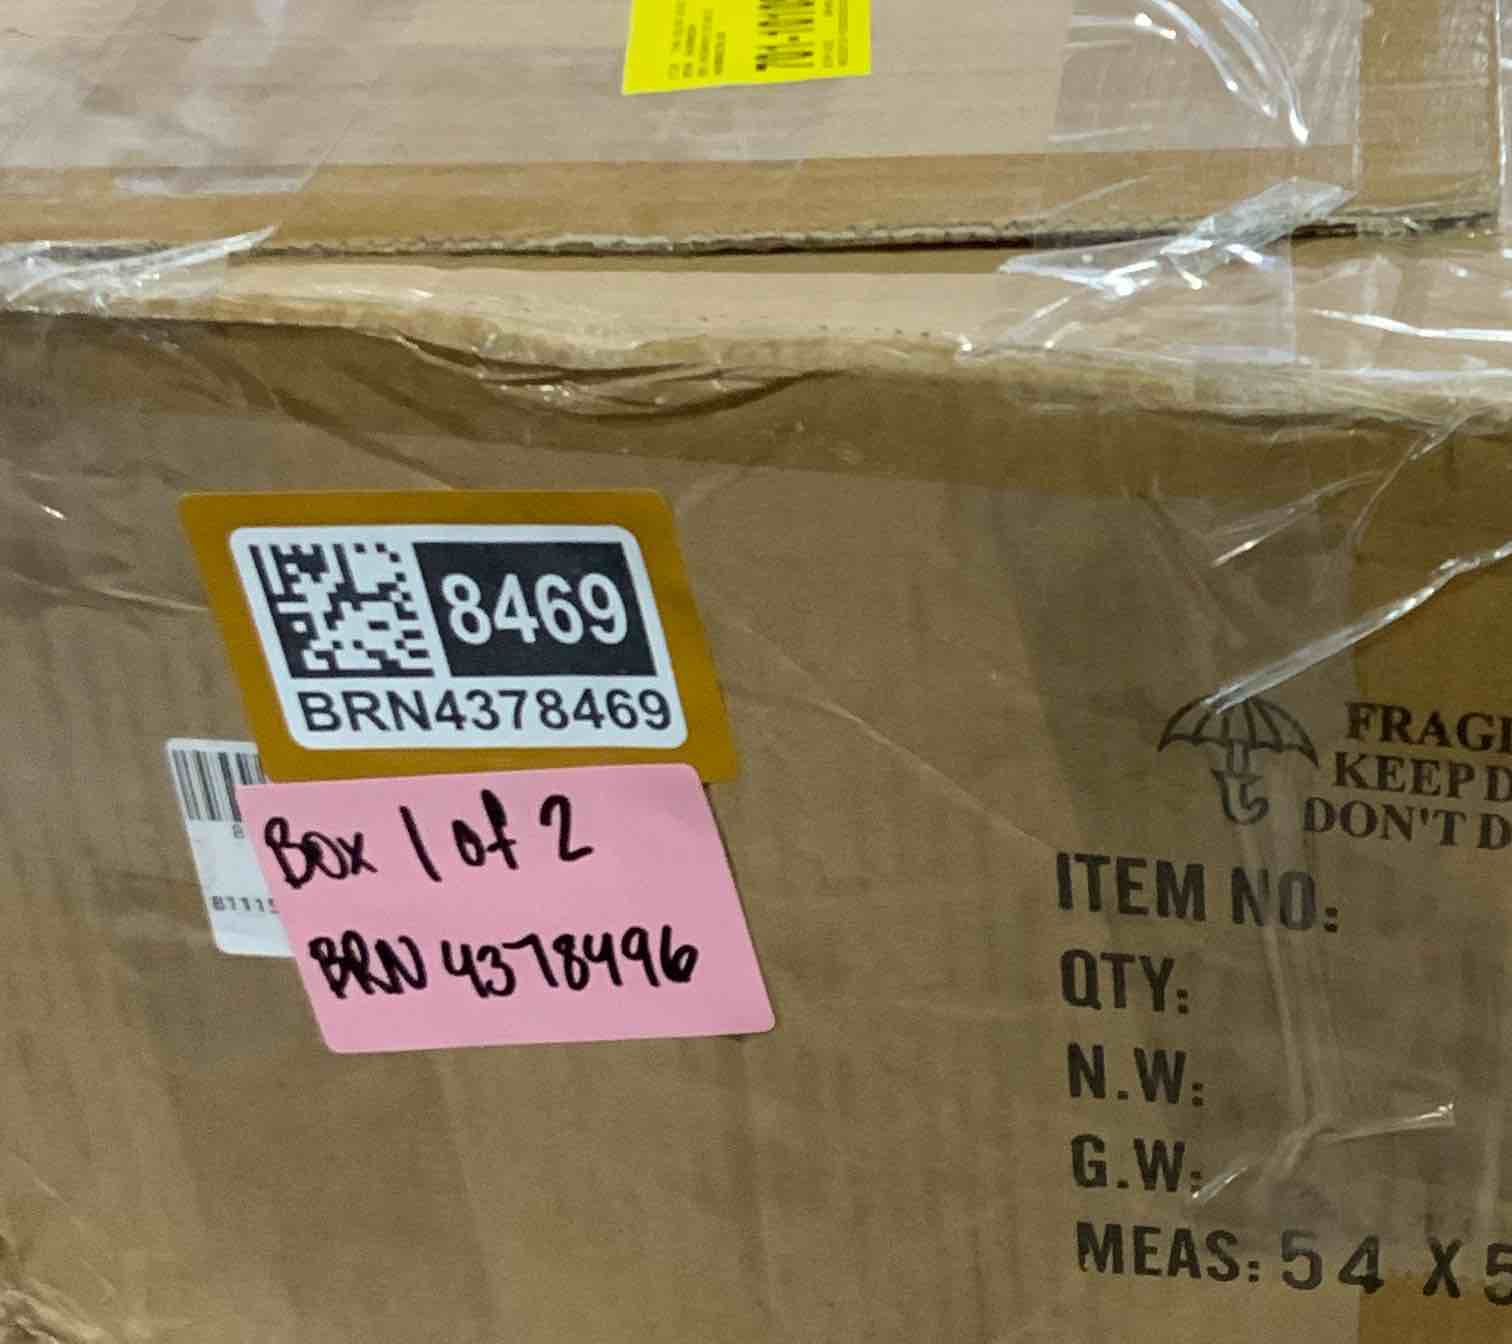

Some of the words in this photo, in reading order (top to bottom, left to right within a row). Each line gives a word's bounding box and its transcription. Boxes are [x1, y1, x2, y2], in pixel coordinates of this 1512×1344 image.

[441, 573, 628, 646] 8469
[299, 689, 673, 732] BRN4378469
[1331, 752, 1476, 800] KEEP
[264, 816, 377, 889] Box
[451, 788, 518, 870] of
[539, 794, 593, 862] 2
[1303, 796, 1467, 848] DON'T
[1055, 851, 1207, 923] ITEM
[1230, 865, 1339, 933] NO:
[308, 929, 428, 1000] BRN
[440, 924, 699, 998] 4378496
[1060, 948, 1190, 1015] QTY:
[1066, 1042, 1204, 1107] N.W:
[1075, 1221, 1260, 1284] MEAS:
[1280, 1228, 1385, 1295] 54
